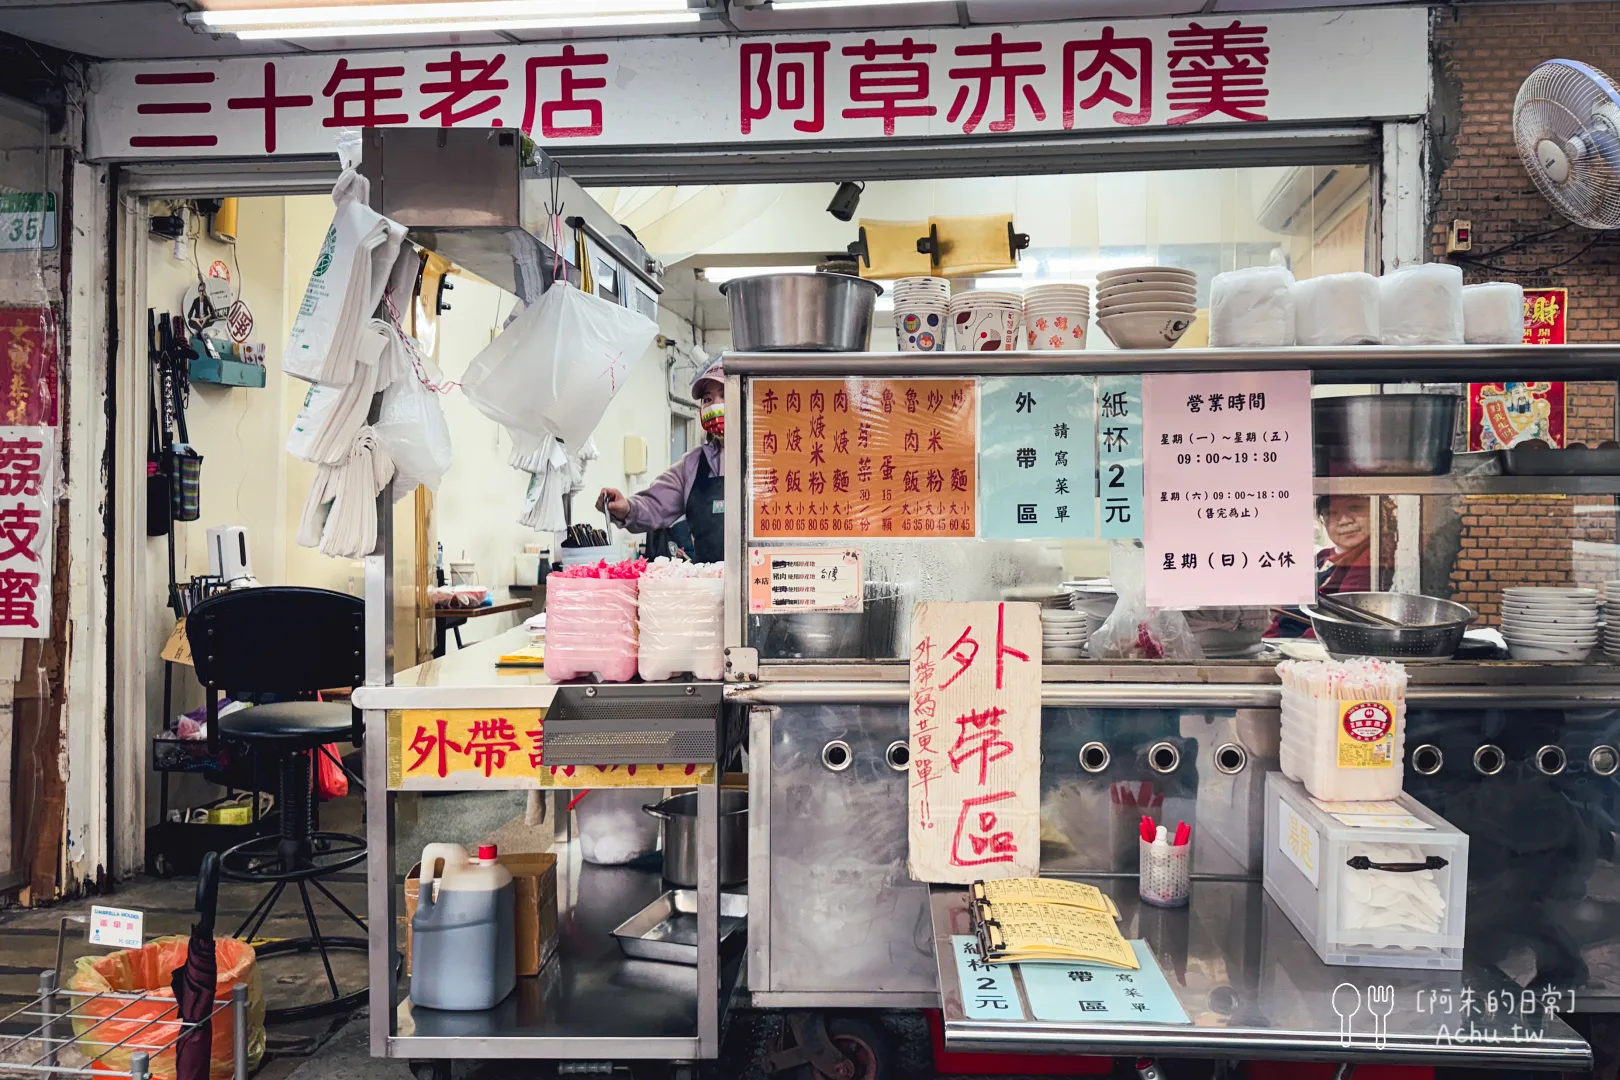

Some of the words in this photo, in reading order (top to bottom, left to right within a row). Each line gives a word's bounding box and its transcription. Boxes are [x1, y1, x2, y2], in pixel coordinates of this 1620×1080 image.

[129, 45, 609, 153] 三十年老店
[740, 20, 1270, 136] 阿草赤肉羹
[9, 217, 38, 242] 35
[857, 385, 872, 482] 豆芽菜
[880, 388, 896, 481] 魯蛋
[903, 388, 920, 493] 魯肉飯
[926, 389, 944, 495] 炒米粉
[950, 389, 968, 493] 炒麵
[1186, 392, 1266, 413] 營業時間
[1015, 391, 1038, 524] 外帶區
[1053, 422, 1070, 523] 請寫菜單
[1101, 391, 1131, 523] 紙杯2元
[753, 577, 769, 585] 本店
[1162, 551, 1296, 570] 星期（日）公休
[938, 601, 1031, 866] 外帶區
